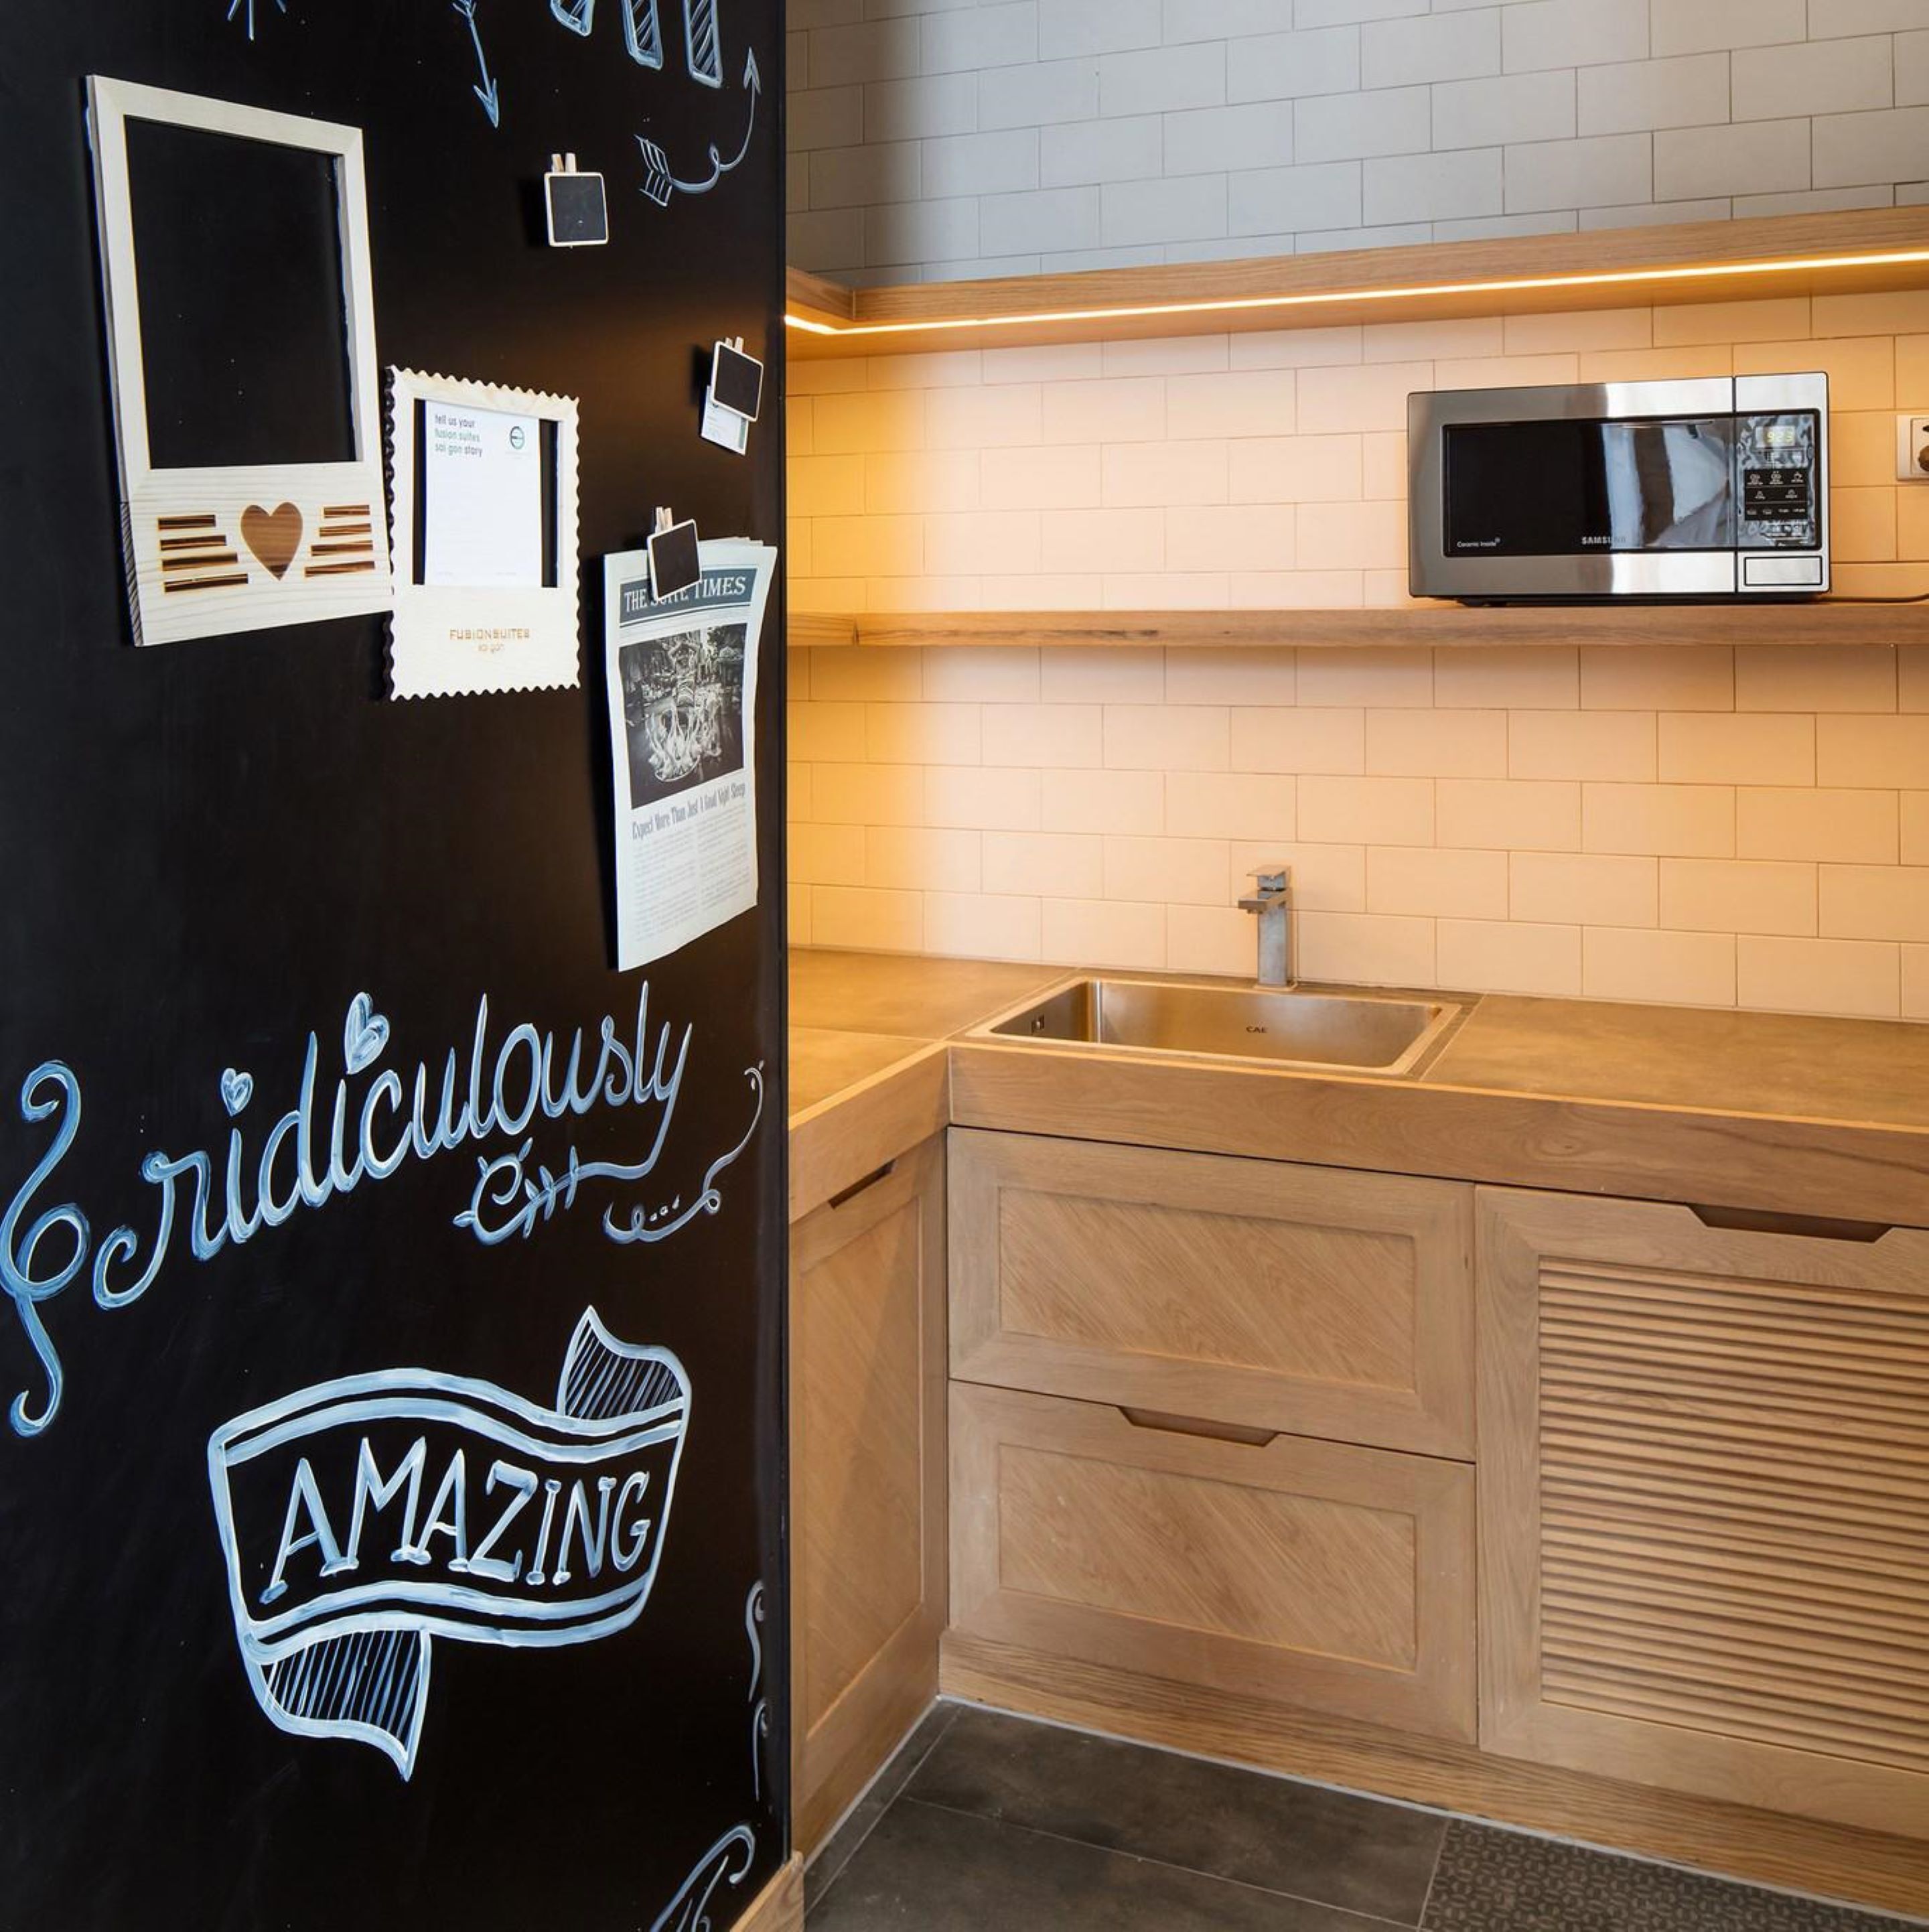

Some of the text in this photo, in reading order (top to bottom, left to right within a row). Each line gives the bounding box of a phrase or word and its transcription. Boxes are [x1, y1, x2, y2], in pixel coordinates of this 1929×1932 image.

[434, 415, 475, 428] tell us your
[434, 429, 480, 442] fusion suites
[464, 445, 482, 458] story
[624, 589, 647, 612] THE
[695, 576, 746, 600] TIMES
[632, 816, 652, 840] Expect
[655, 813, 670, 831] More
[672, 807, 686, 824] Than
[688, 799, 698, 817] Just
[93, 980, 692, 1310] ridiculously
[260, 1436, 652, 1604] AMAZING
